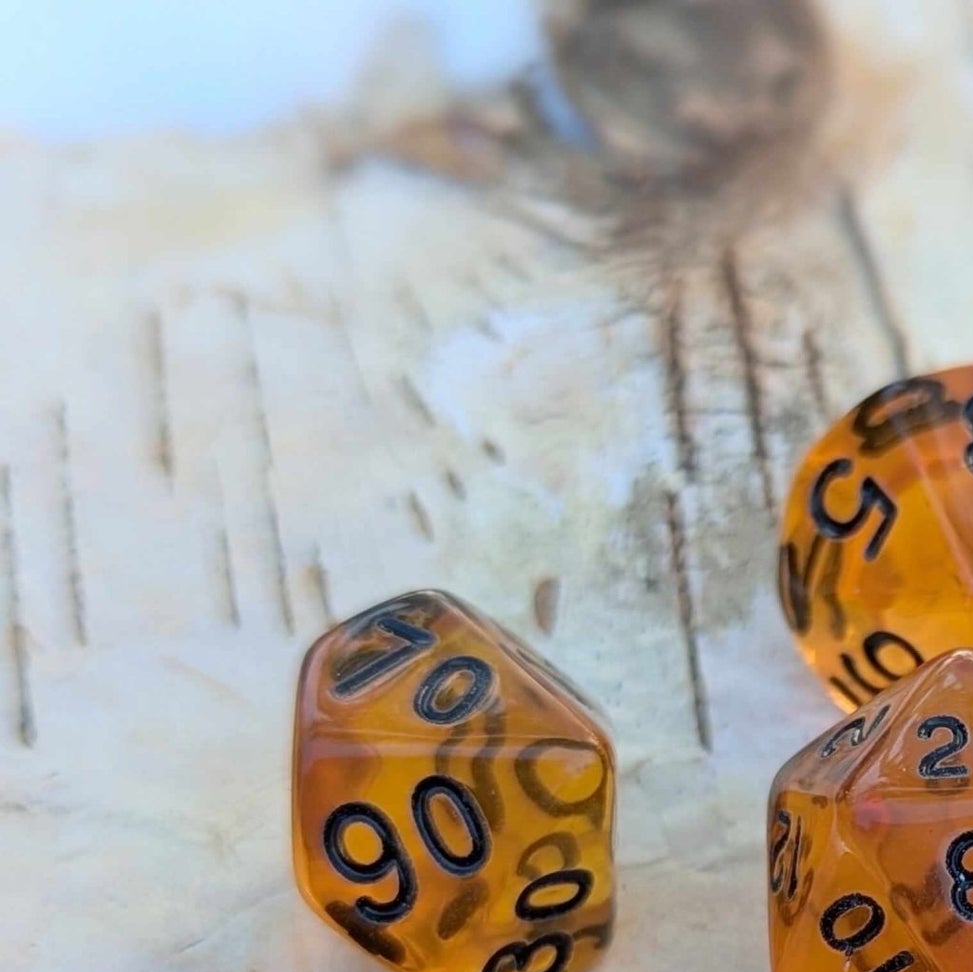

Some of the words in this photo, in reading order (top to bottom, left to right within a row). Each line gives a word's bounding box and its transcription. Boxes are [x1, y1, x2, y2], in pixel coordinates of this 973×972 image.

[809, 458, 898, 562] 5
[333, 616, 493, 725] 70
[323, 774, 492, 924] 90
